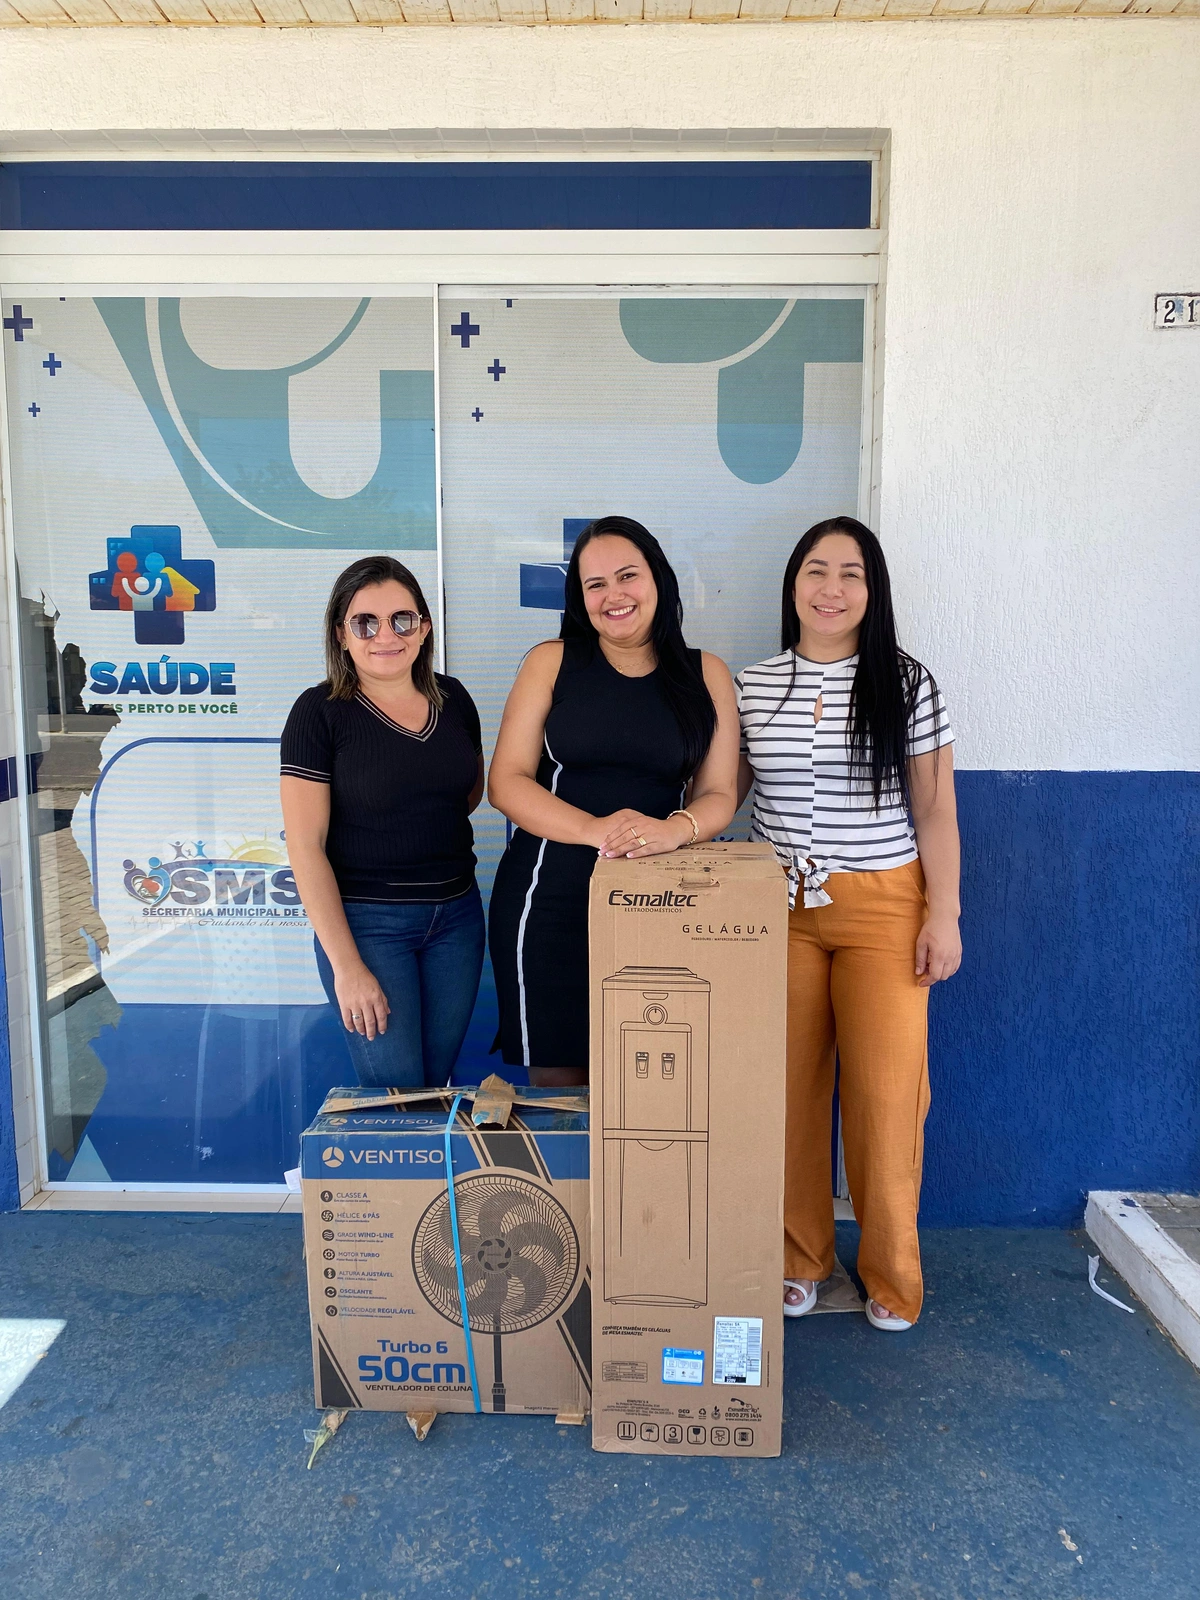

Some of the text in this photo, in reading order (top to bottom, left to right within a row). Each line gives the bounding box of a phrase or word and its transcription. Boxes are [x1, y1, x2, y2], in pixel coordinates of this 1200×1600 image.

[89, 654, 237, 695] SAÚDE
[128, 703, 175, 714] PERTO
[178, 704, 197, 714] DE
[199, 701, 238, 714] VOCÊ
[608, 889, 698, 907] Esmaltec
[142, 907, 214, 917] SECRETARIA
[217, 908, 280, 917] MUNICIPAL
[284, 908, 299, 917] DE
[260, 919, 274, 927] da
[682, 923, 769, 935] GELÁGUA
[377, 1339, 448, 1354] Turbo 6
[358, 1355, 466, 1384] 50cm
[365, 1384, 422, 1392] VENTILADOR
[669, 1426, 677, 1439] 3
